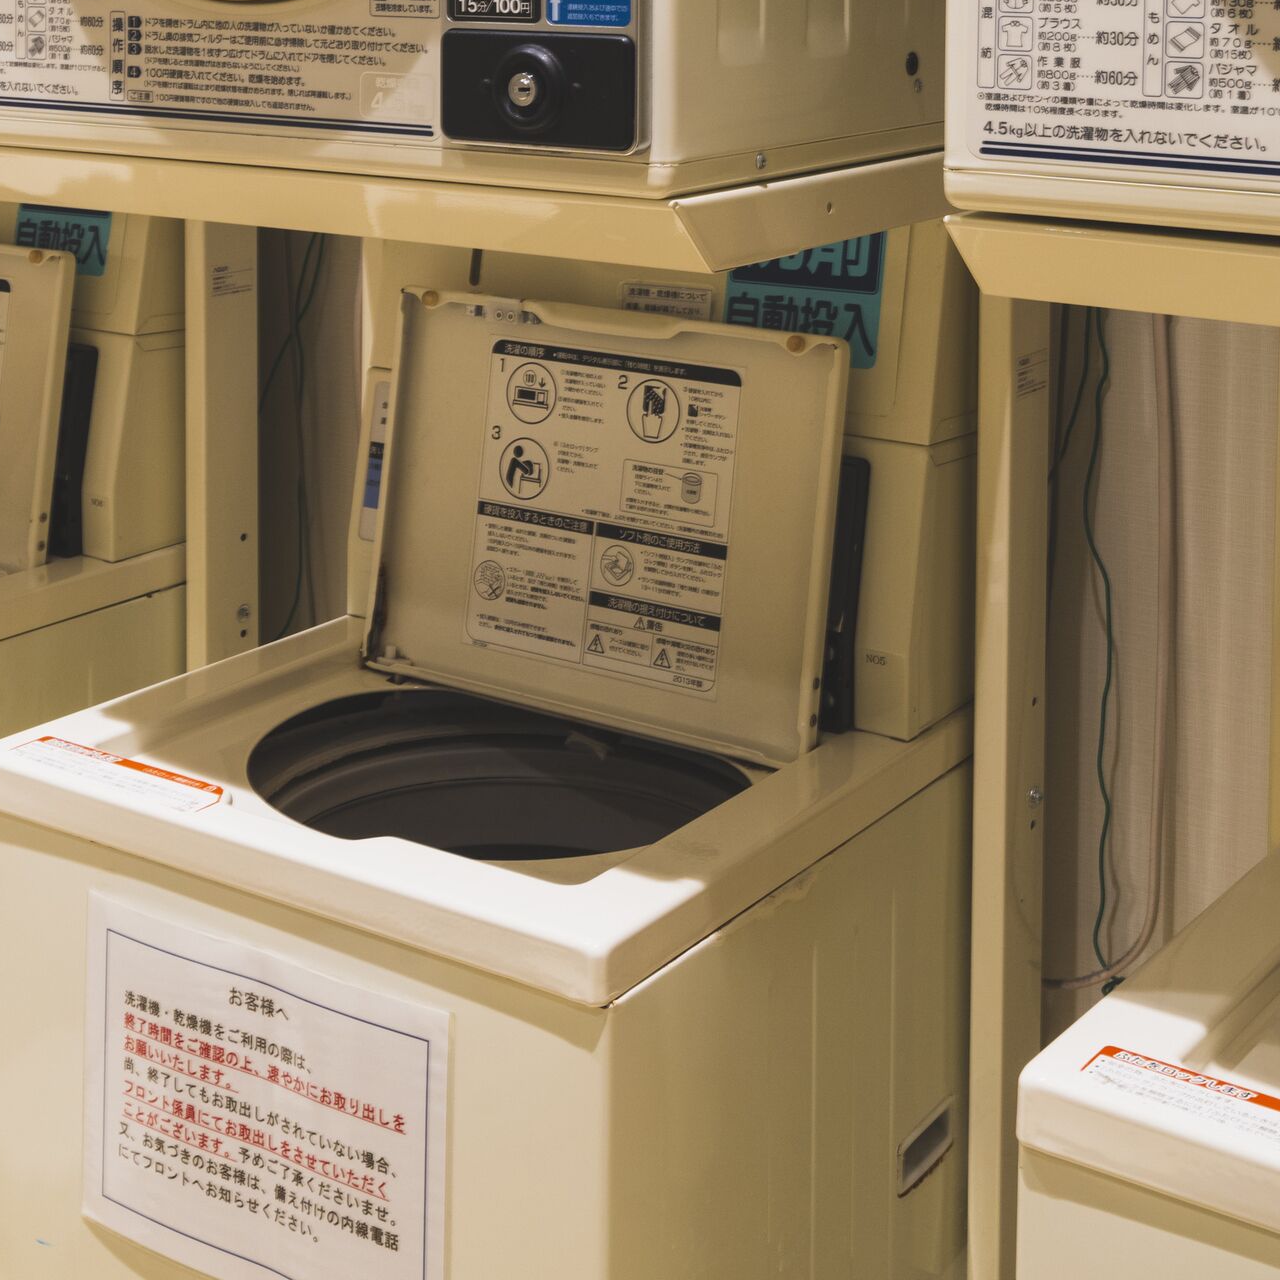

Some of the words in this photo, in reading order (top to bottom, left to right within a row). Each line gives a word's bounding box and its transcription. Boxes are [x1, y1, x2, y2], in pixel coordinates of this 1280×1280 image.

[1039, 18, 1082, 29] ブラウス
[1095, 30, 1139, 46] 約30分
[1094, 70, 1138, 86] 約60分
[1208, 63, 1258, 76] パジャマ
[20, 218, 106, 267] 自動投入
[728, 291, 874, 357] 自動投入
[124, 990, 313, 1073] 洗濯機・乾燥機をご利用の際は、
[228, 987, 289, 1020] お客様へ
[123, 1034, 234, 1090] お願いいたします。
[123, 1012, 406, 1132] 終了時間をご確認の上、速やかにお取り出しを
[123, 1057, 398, 1178] 尚、終了してもお取出しがされていない場合、
[123, 1080, 390, 1200] フロント係員にてお取出しをさせていただく
[118, 1144, 319, 1244] にてフロントへお知らせください。
[119, 1122, 400, 1252] 又、お気づきのお客様は、備え付けの内線電話
